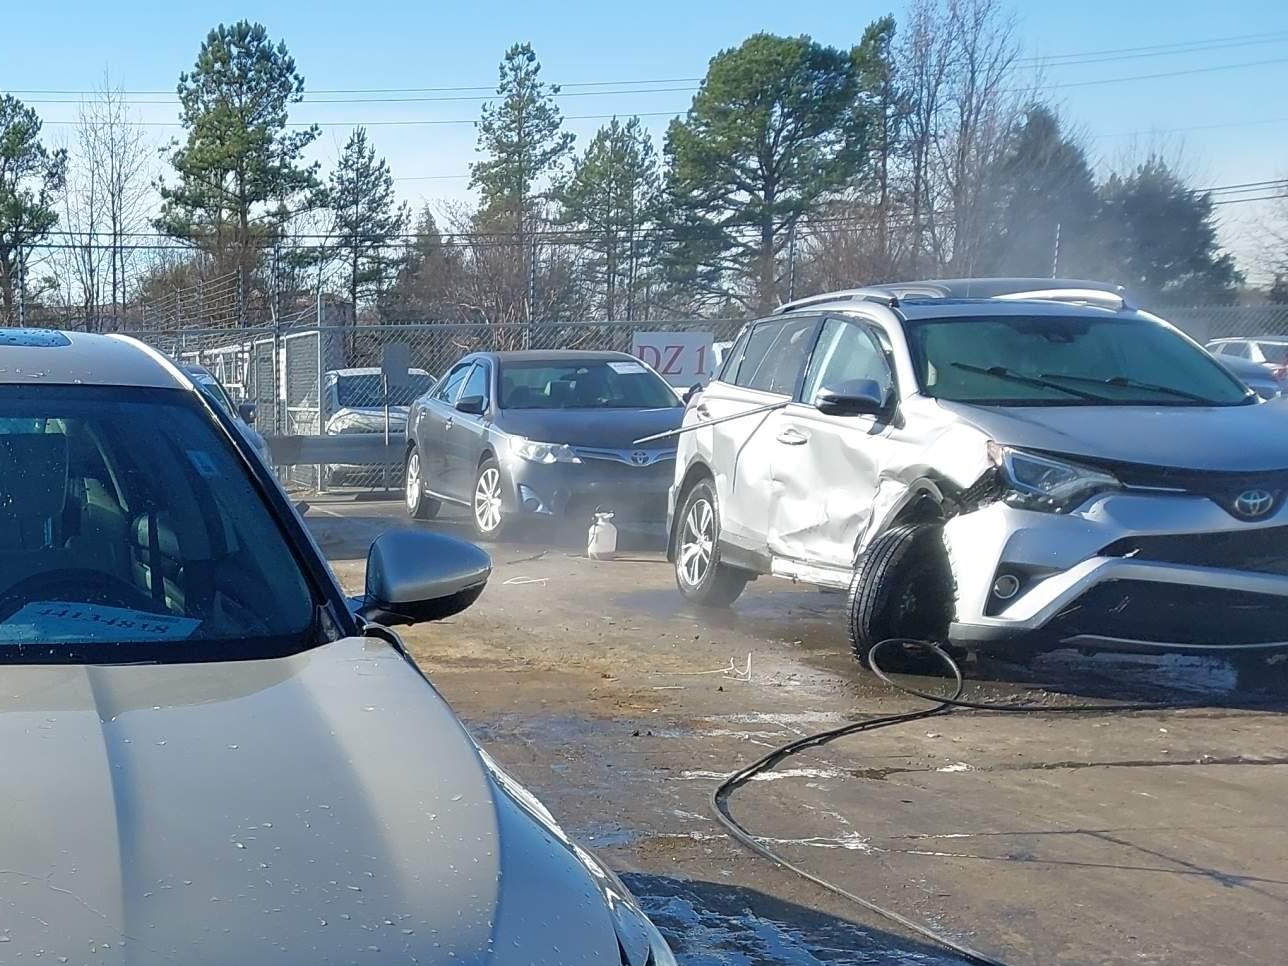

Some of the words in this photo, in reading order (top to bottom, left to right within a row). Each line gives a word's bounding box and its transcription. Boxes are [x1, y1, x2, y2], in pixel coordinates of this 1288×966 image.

[637, 344, 685, 375] DZ
[694, 344, 707, 375] 1
[37, 608, 168, 633] 44134818
